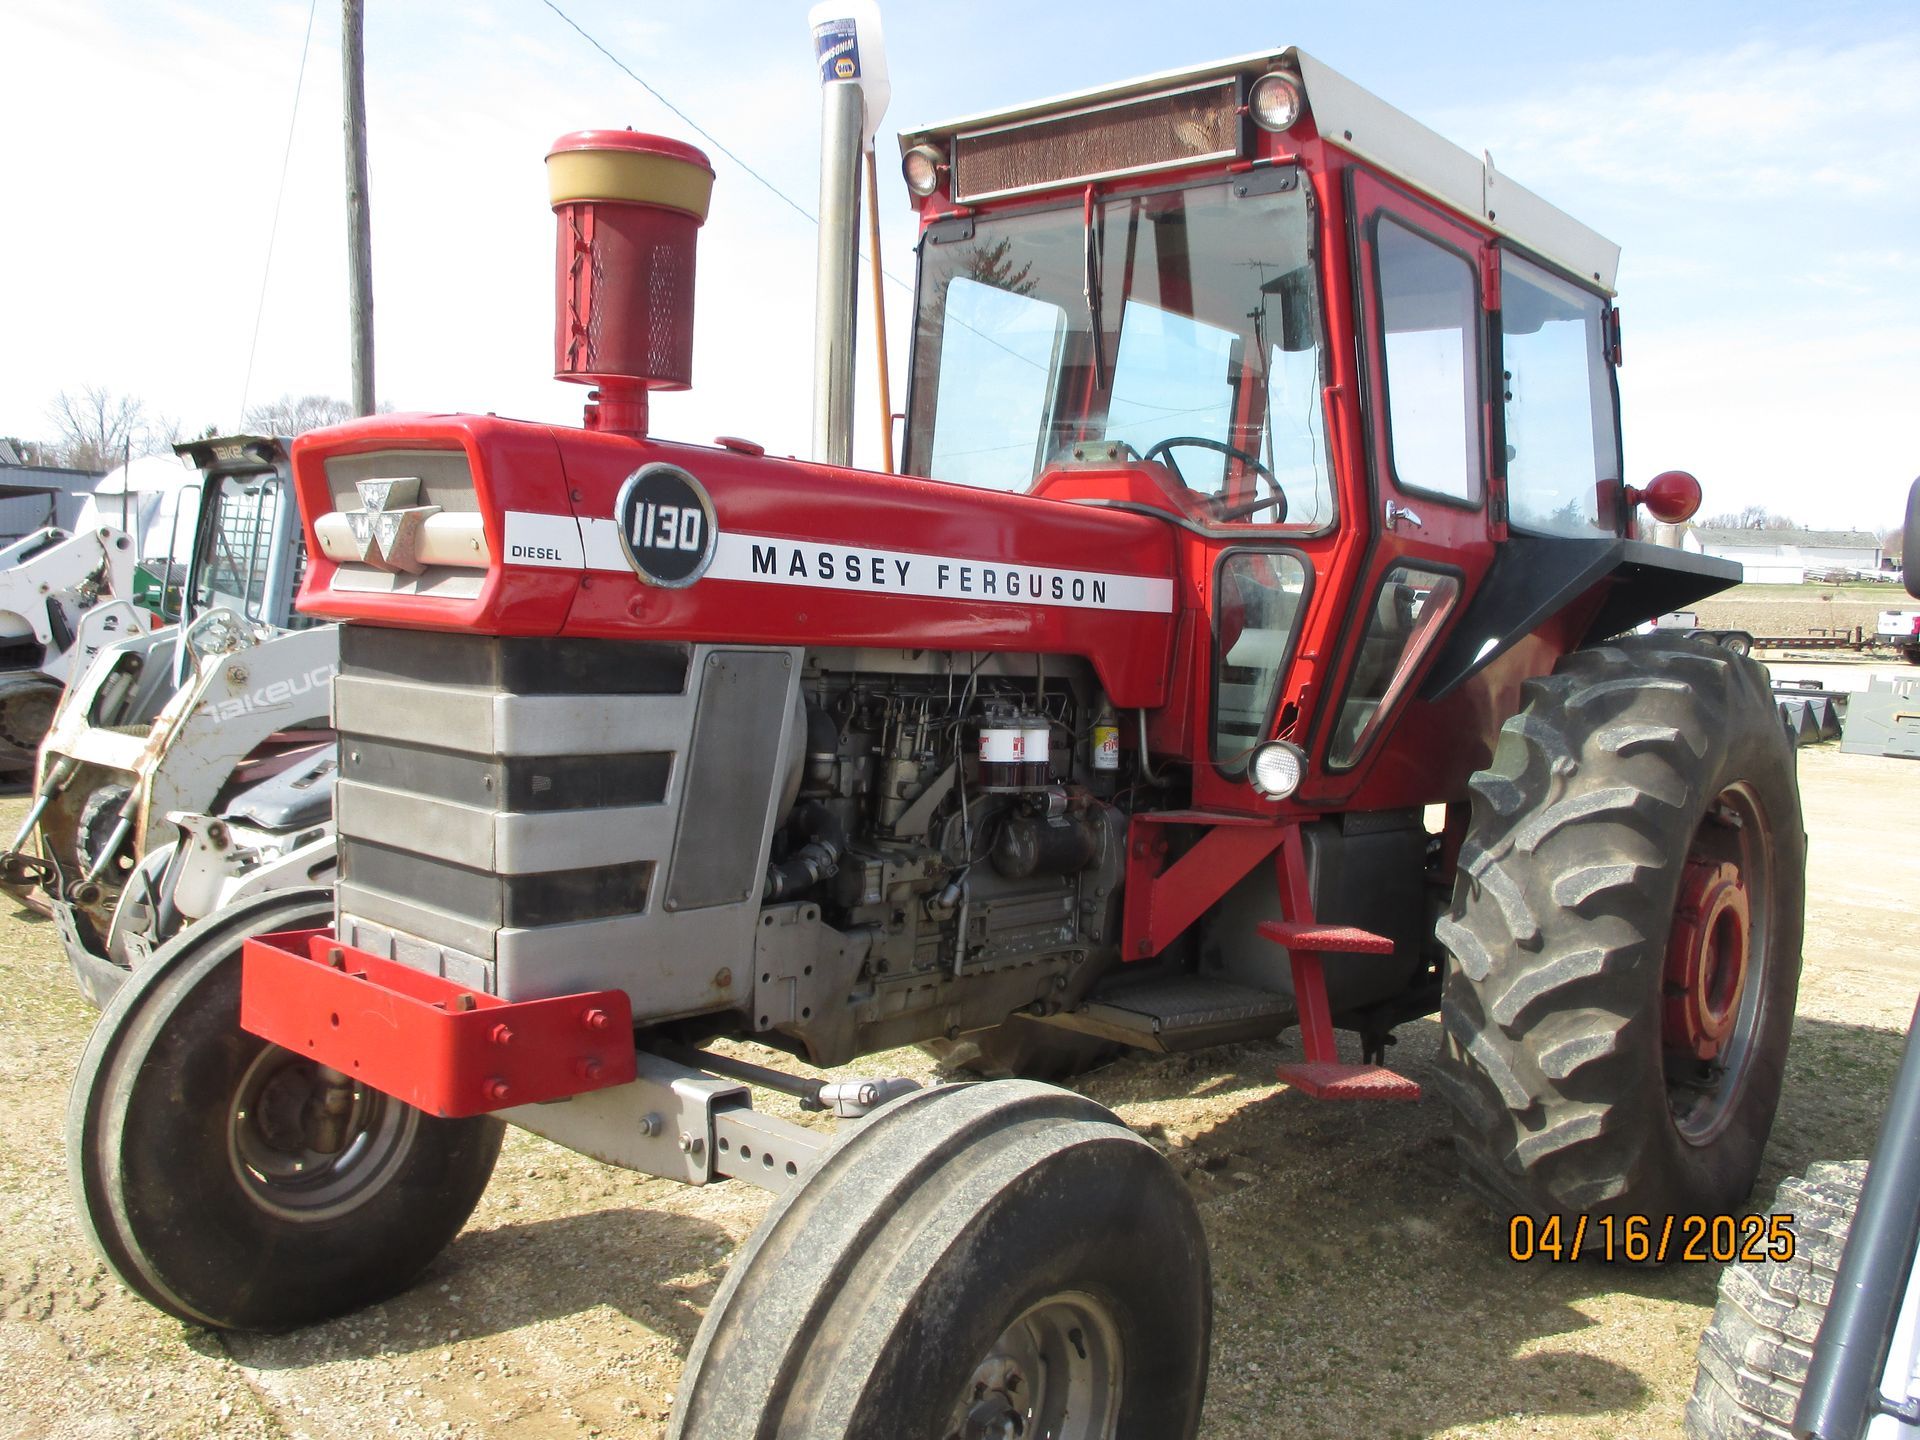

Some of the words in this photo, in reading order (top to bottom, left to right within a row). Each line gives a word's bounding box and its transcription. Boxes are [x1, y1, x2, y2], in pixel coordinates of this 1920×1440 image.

[632, 502, 702, 551] 1130
[512, 545, 562, 560] DIESEL
[752, 544, 911, 587] MASSEY
[938, 564, 1106, 604] FERGUSON
